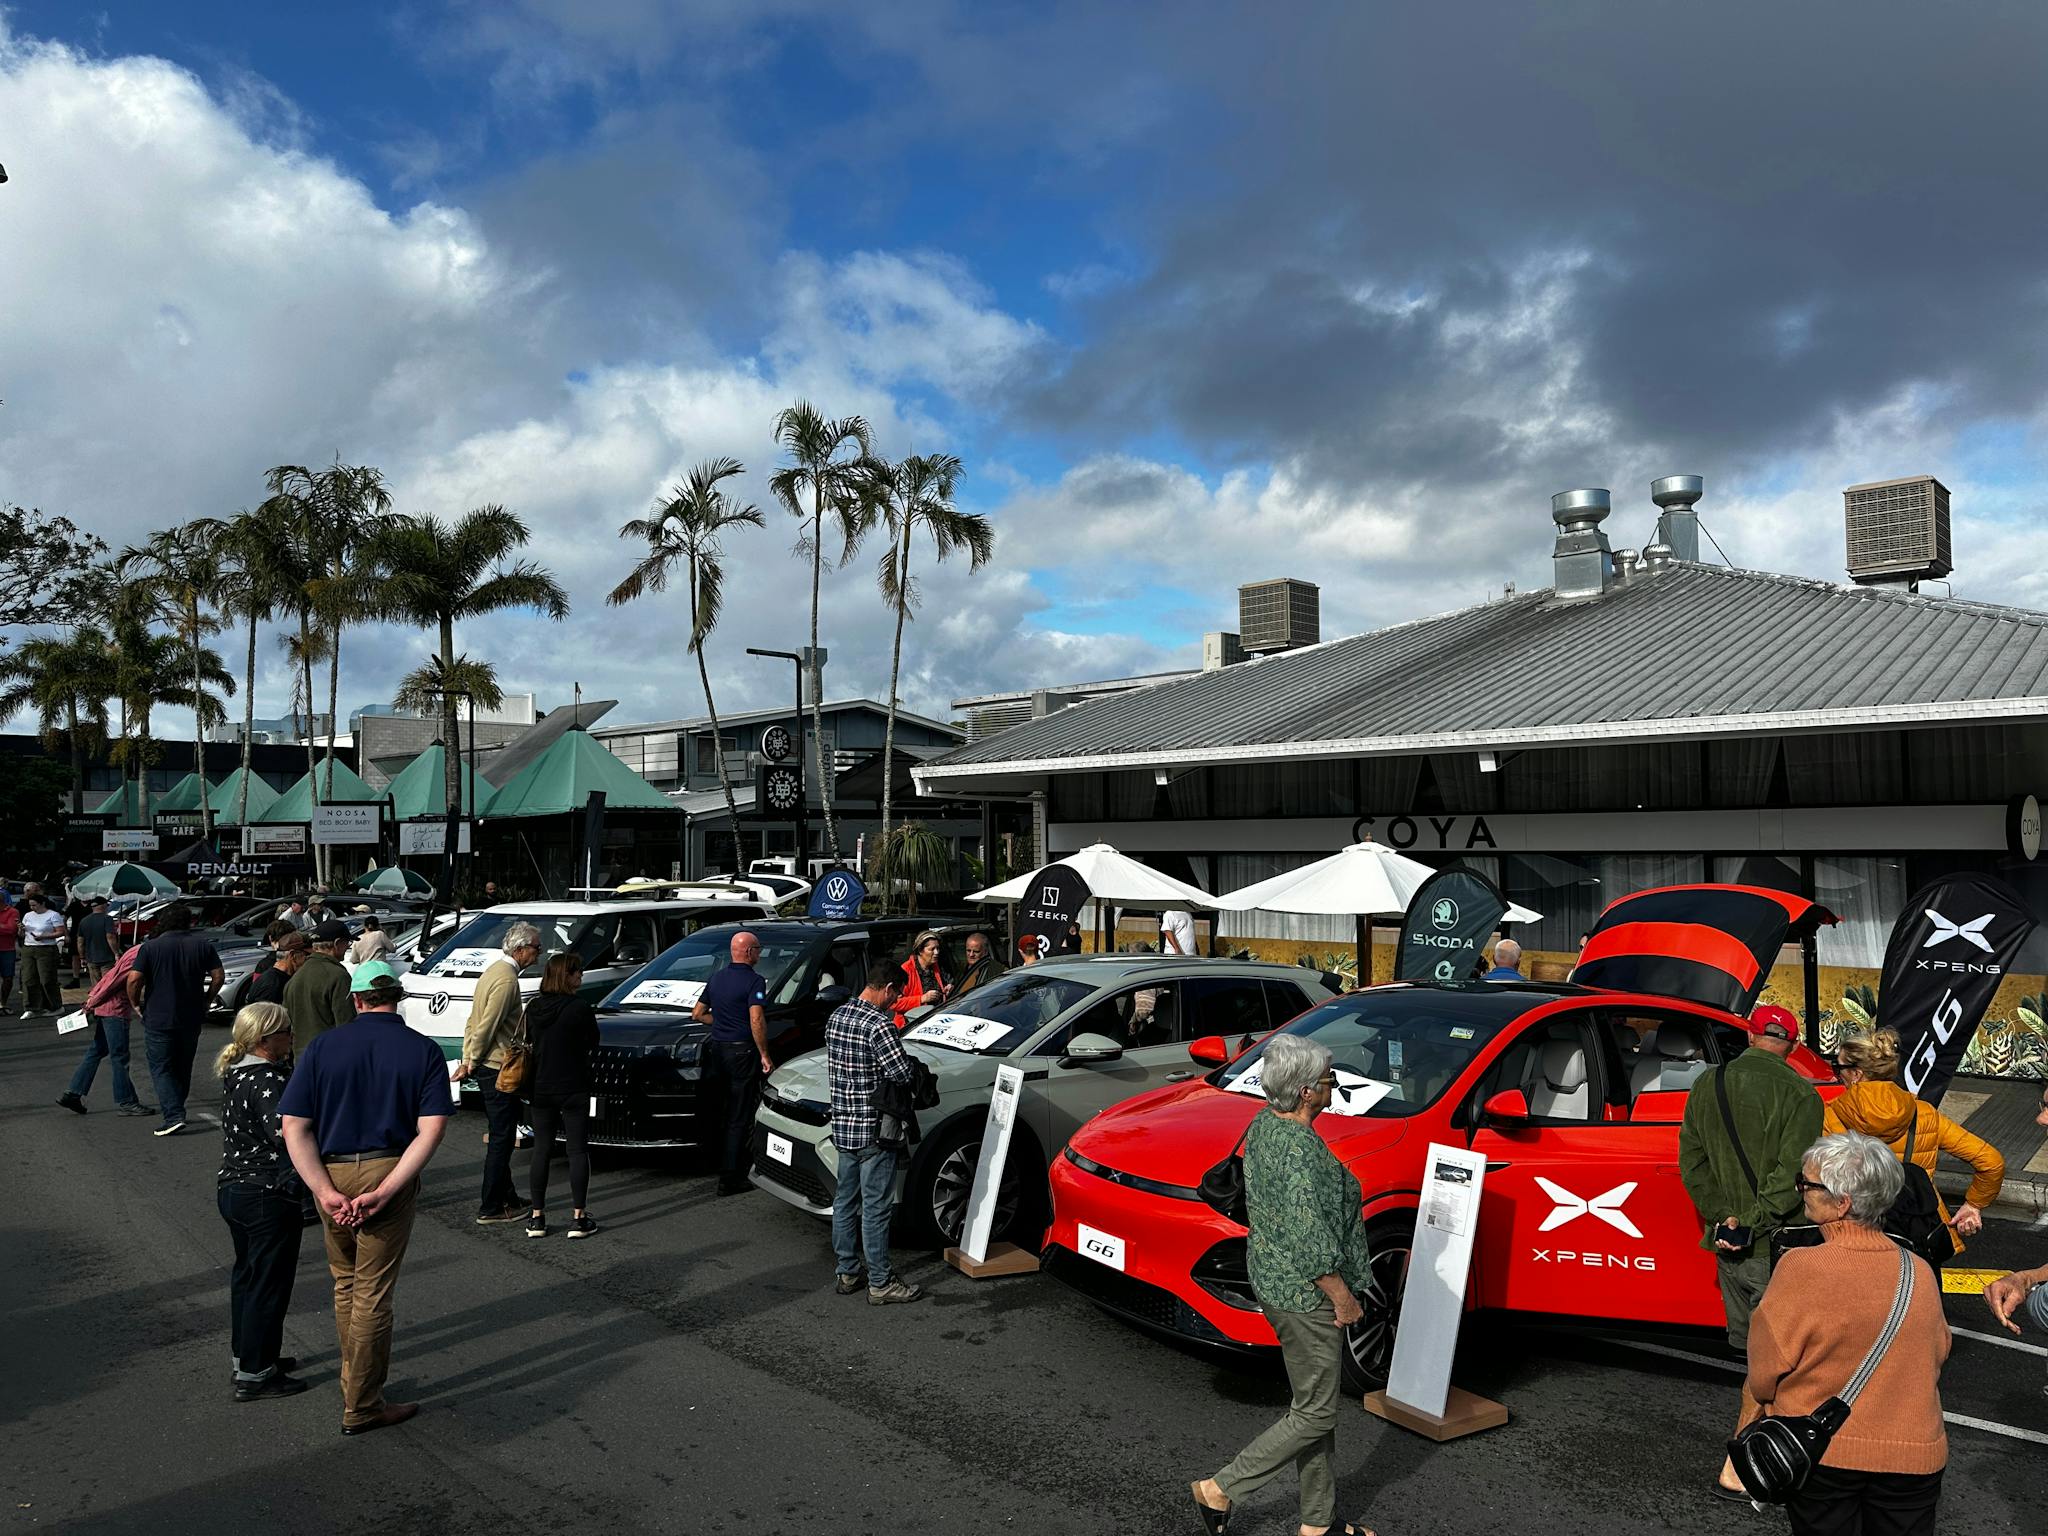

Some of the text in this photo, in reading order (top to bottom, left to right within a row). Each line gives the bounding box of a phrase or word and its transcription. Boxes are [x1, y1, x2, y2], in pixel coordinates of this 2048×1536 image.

[767, 770, 798, 787] VILLAGE
[327, 809, 367, 817] NOOSA
[68, 818, 105, 826] MERMAIDS
[156, 815, 180, 825] BLACK
[172, 826, 195, 836] CAFE
[1352, 815, 1498, 849] COYA
[107, 840, 155, 848] rainbow fun
[412, 841, 446, 849] GALLE
[187, 862, 273, 875] RENAULT
[1028, 909, 1069, 922] ZEEKR
[1412, 933, 1475, 950] SKODA
[1915, 959, 2002, 975] XPENG
[672, 998, 696, 1006] ZEE
[945, 1035, 978, 1048] SKODA
[1903, 987, 1963, 1097] G6
[1086, 1239, 1116, 1259] G6
[1531, 1247, 1657, 1272] XPENG
